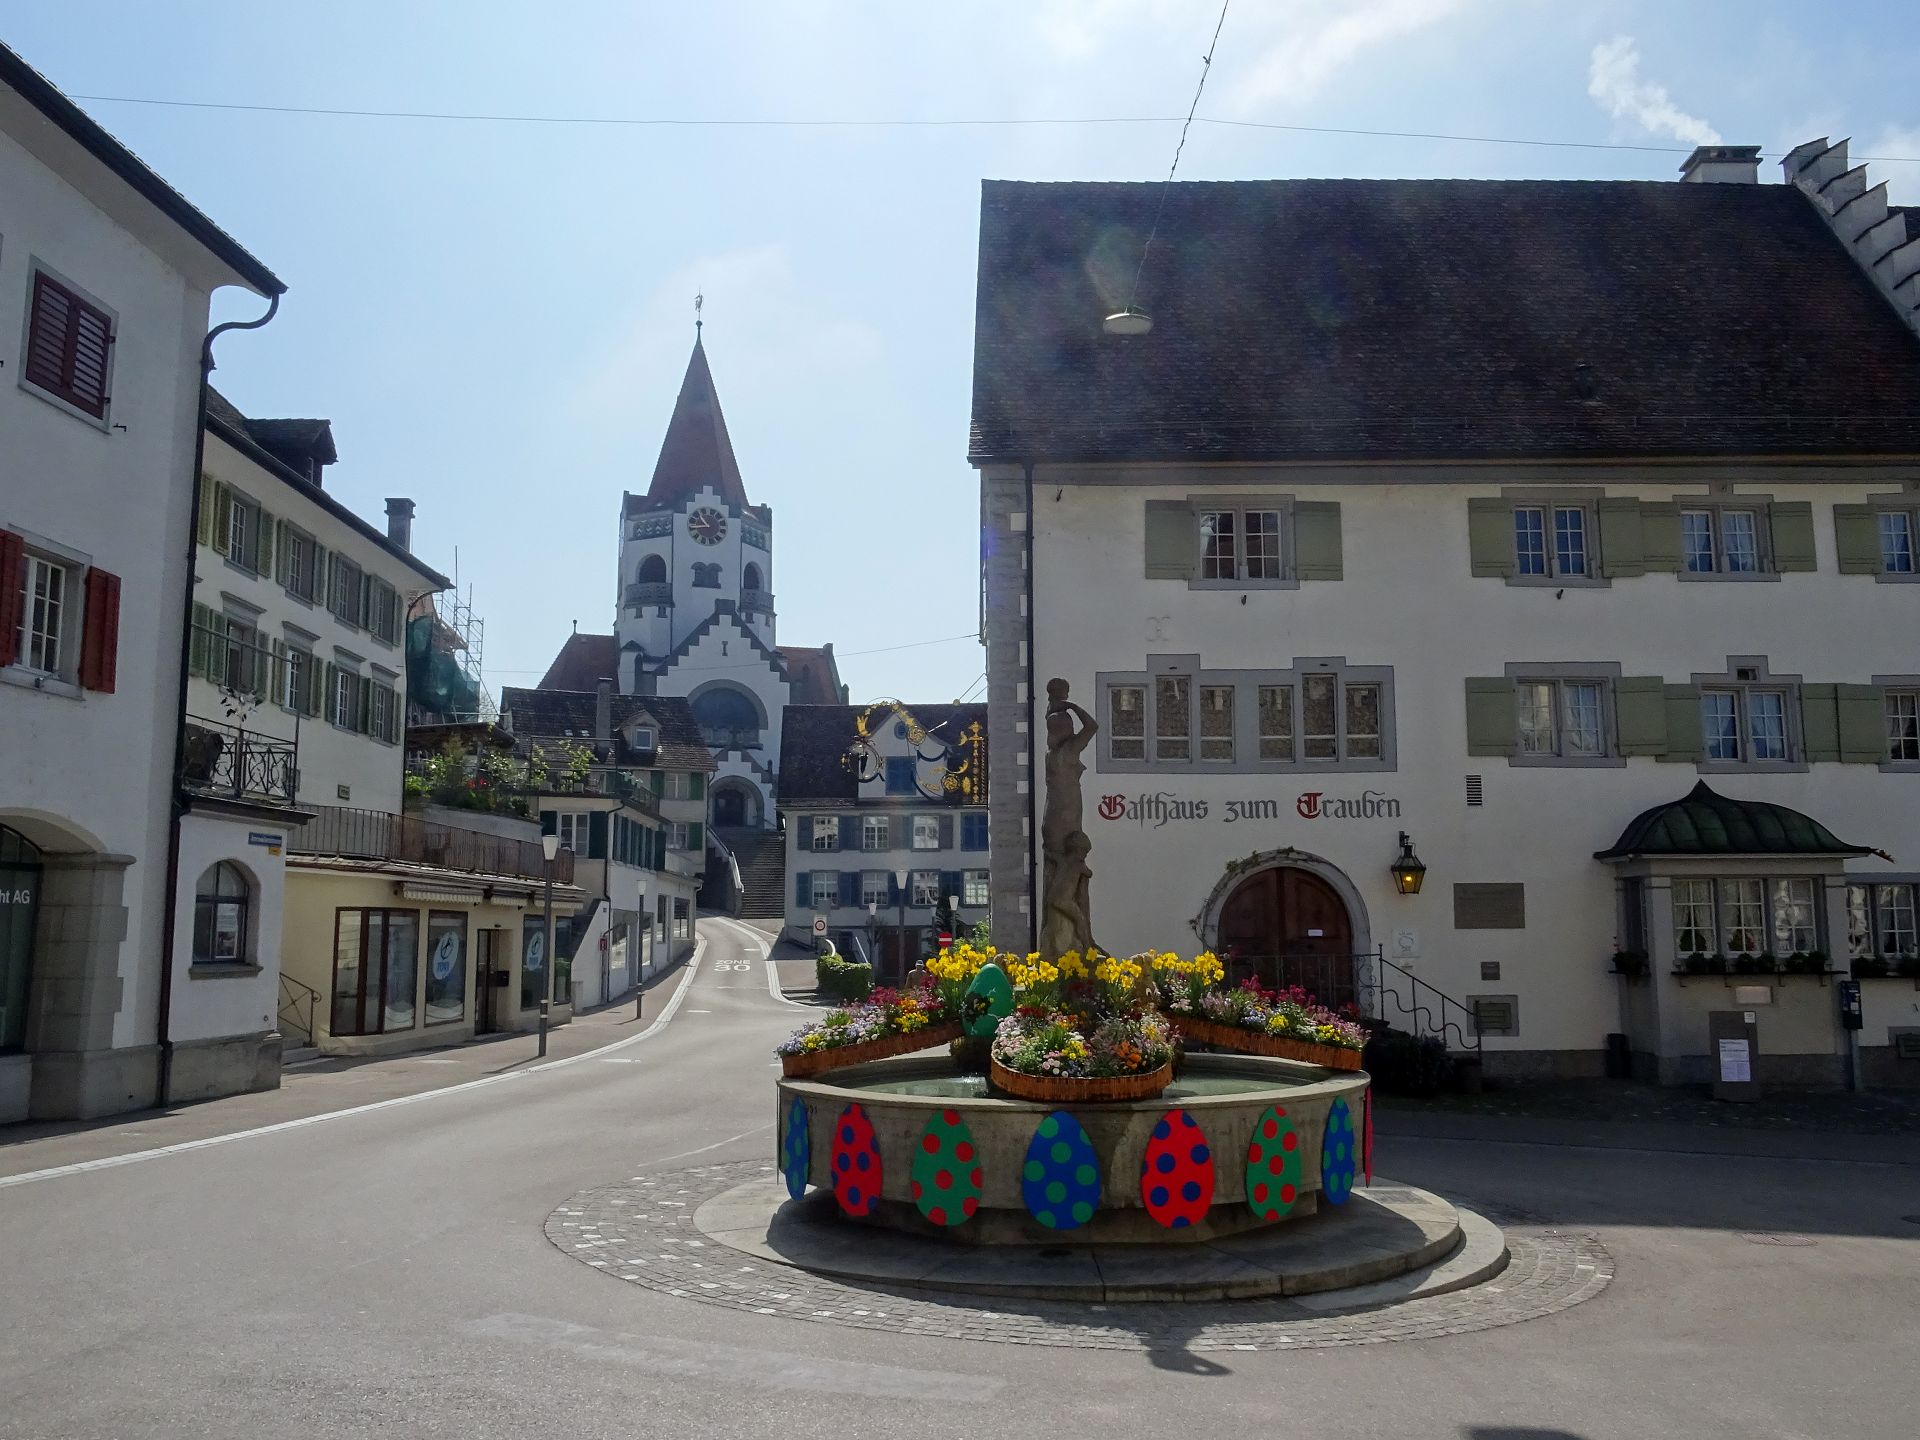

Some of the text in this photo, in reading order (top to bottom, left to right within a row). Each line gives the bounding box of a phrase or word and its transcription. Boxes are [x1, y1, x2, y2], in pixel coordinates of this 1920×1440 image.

[1223, 798, 1278, 823] zum
[1296, 790, 1402, 821] Trauben
[12, 889, 30, 904] AG
[713, 964, 751, 972] 30
